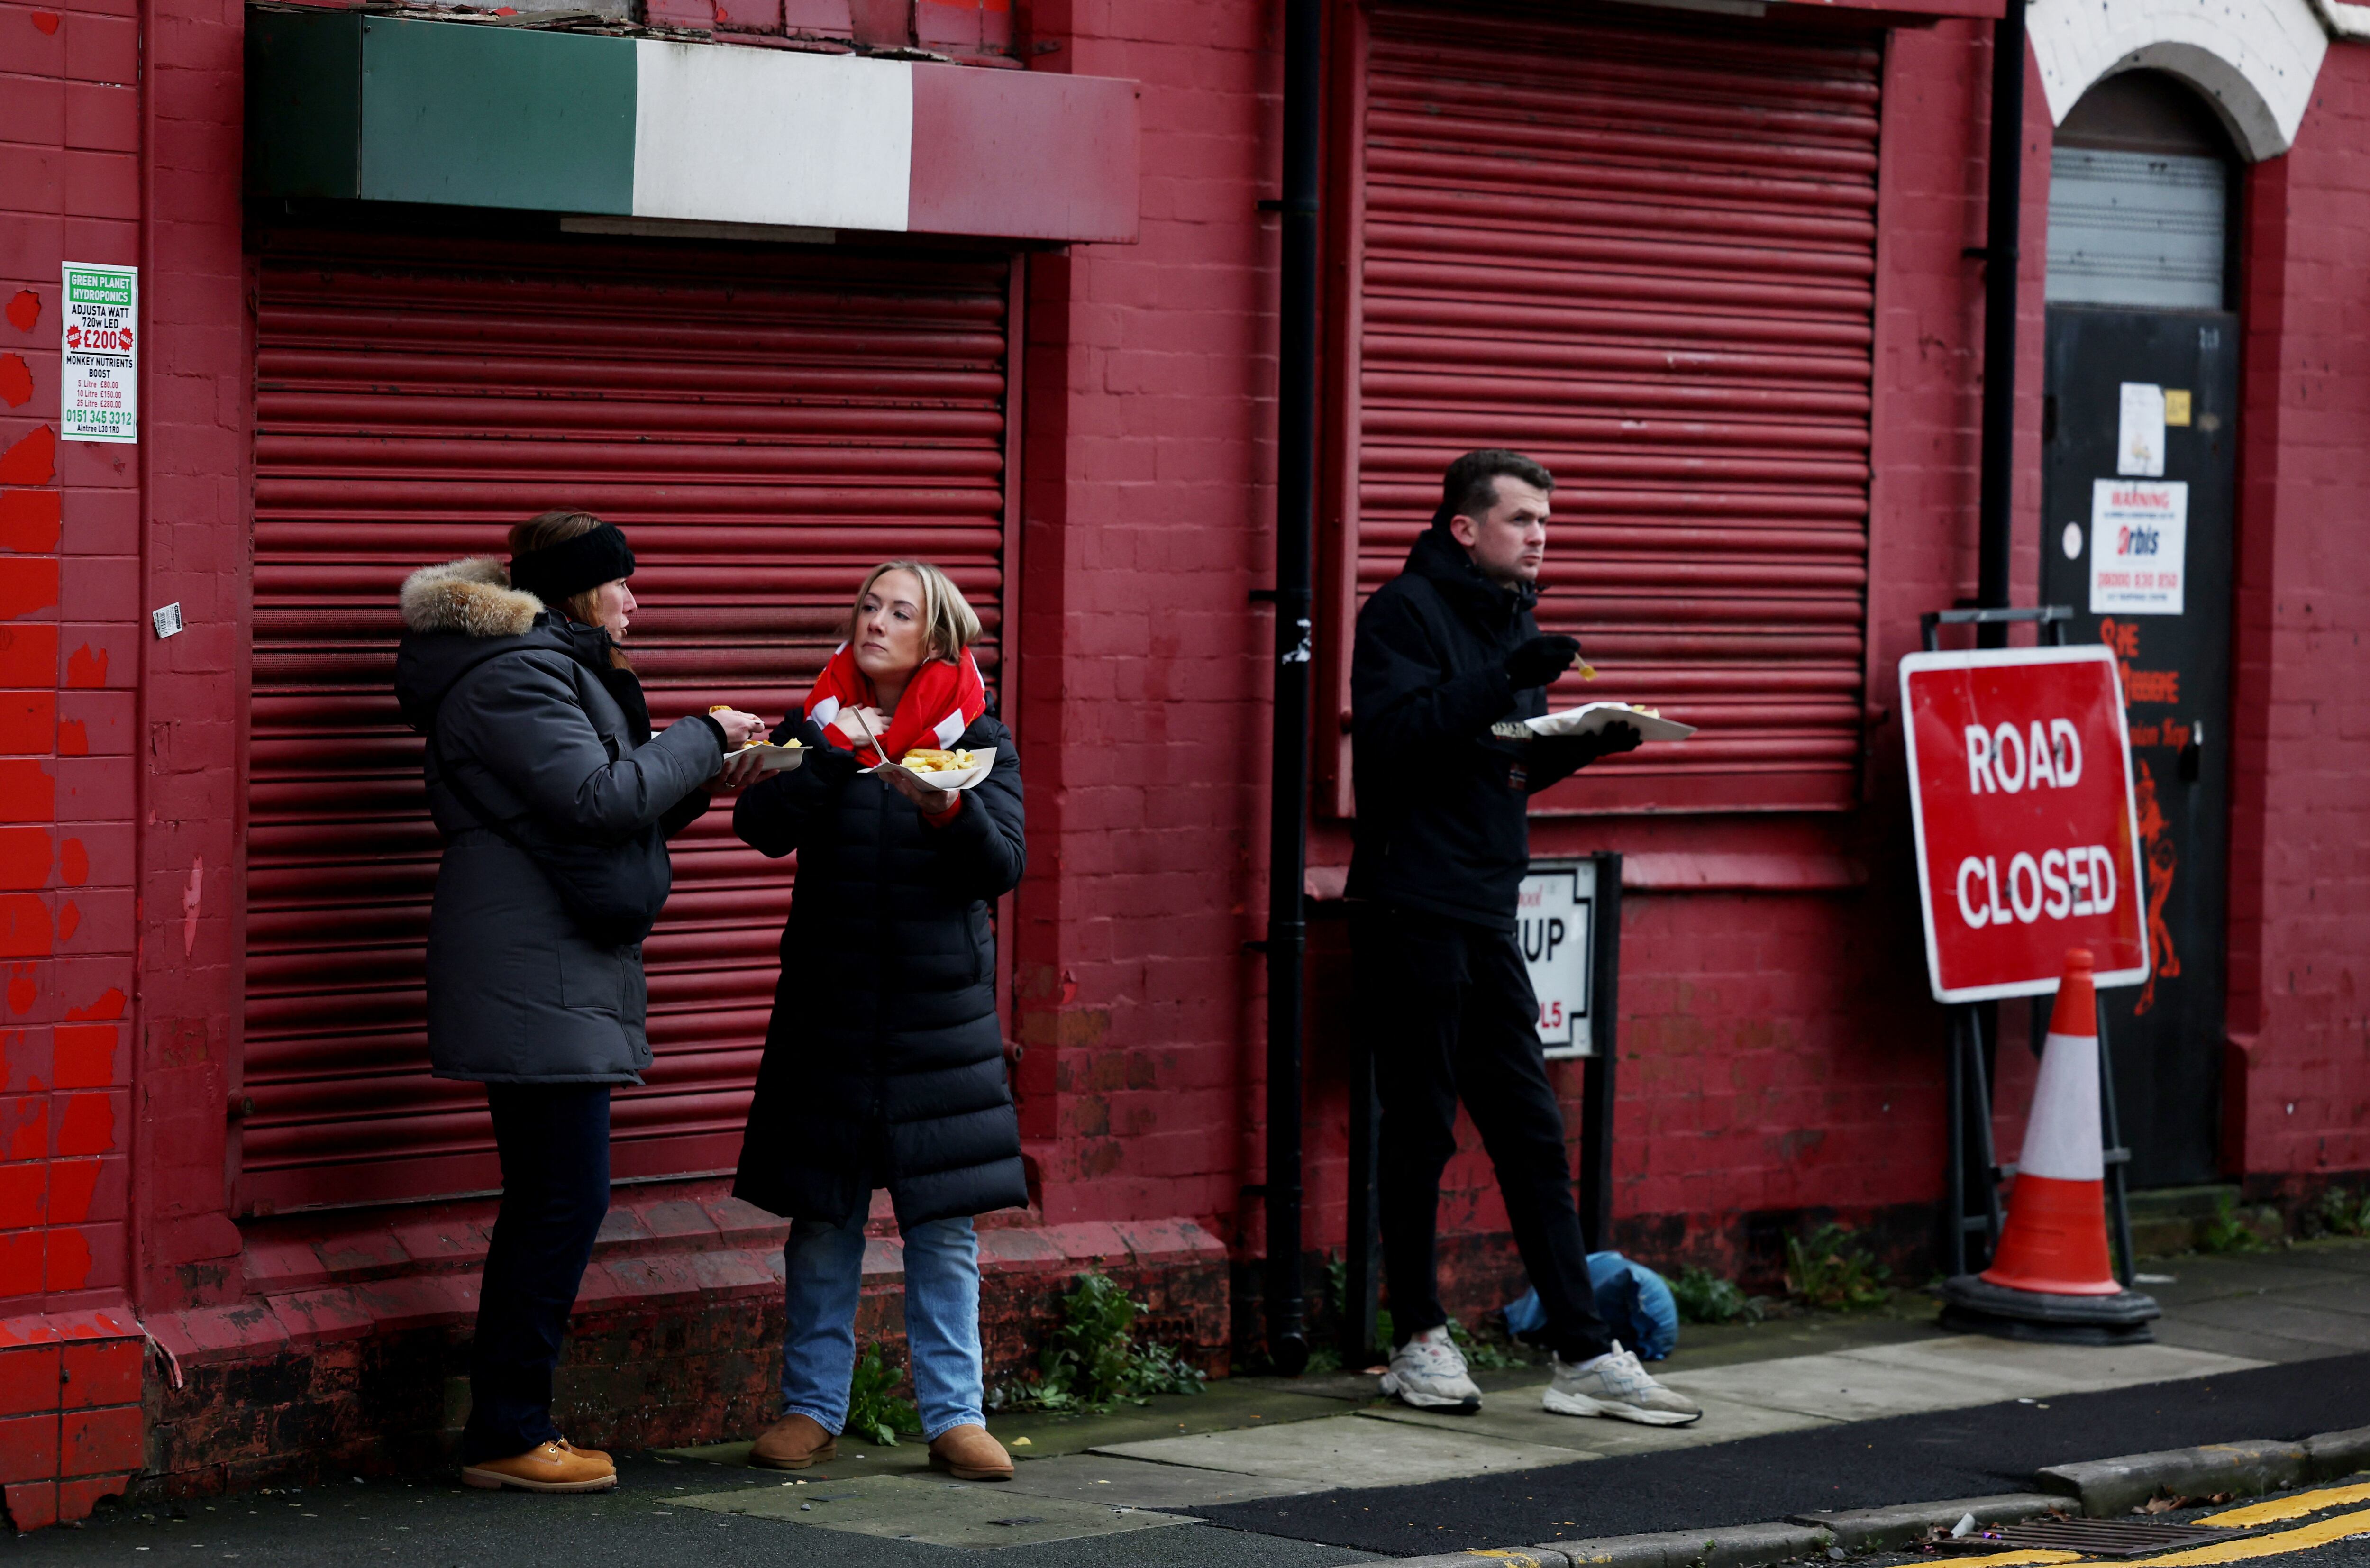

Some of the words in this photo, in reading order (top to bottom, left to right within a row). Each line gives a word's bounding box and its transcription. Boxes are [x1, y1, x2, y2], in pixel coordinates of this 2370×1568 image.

[72, 274, 98, 287] GREEN
[100, 276, 130, 289] PLANET
[73, 288, 128, 302] HYDROPONICS
[72, 304, 106, 316] ADJUSTA
[108, 307, 129, 318] WATT
[104, 318, 118, 329] LED
[84, 329, 117, 349] £200
[66, 356, 94, 366] MONKEY
[96, 357, 133, 368] NUTRIENTS
[89, 369, 110, 378] BOOST
[100, 381, 118, 389] £80.00
[100, 391, 121, 399] £150.00
[100, 400, 121, 408] £280.00
[66, 409, 87, 423] 0151
[90, 410, 107, 424] 345
[109, 411, 132, 425] 3312
[77, 424, 97, 432] Aintree
[2111, 491, 2169, 509] WARNING
[1965, 718, 2082, 795] ROAD
[1957, 845, 2117, 929] CLOSED
